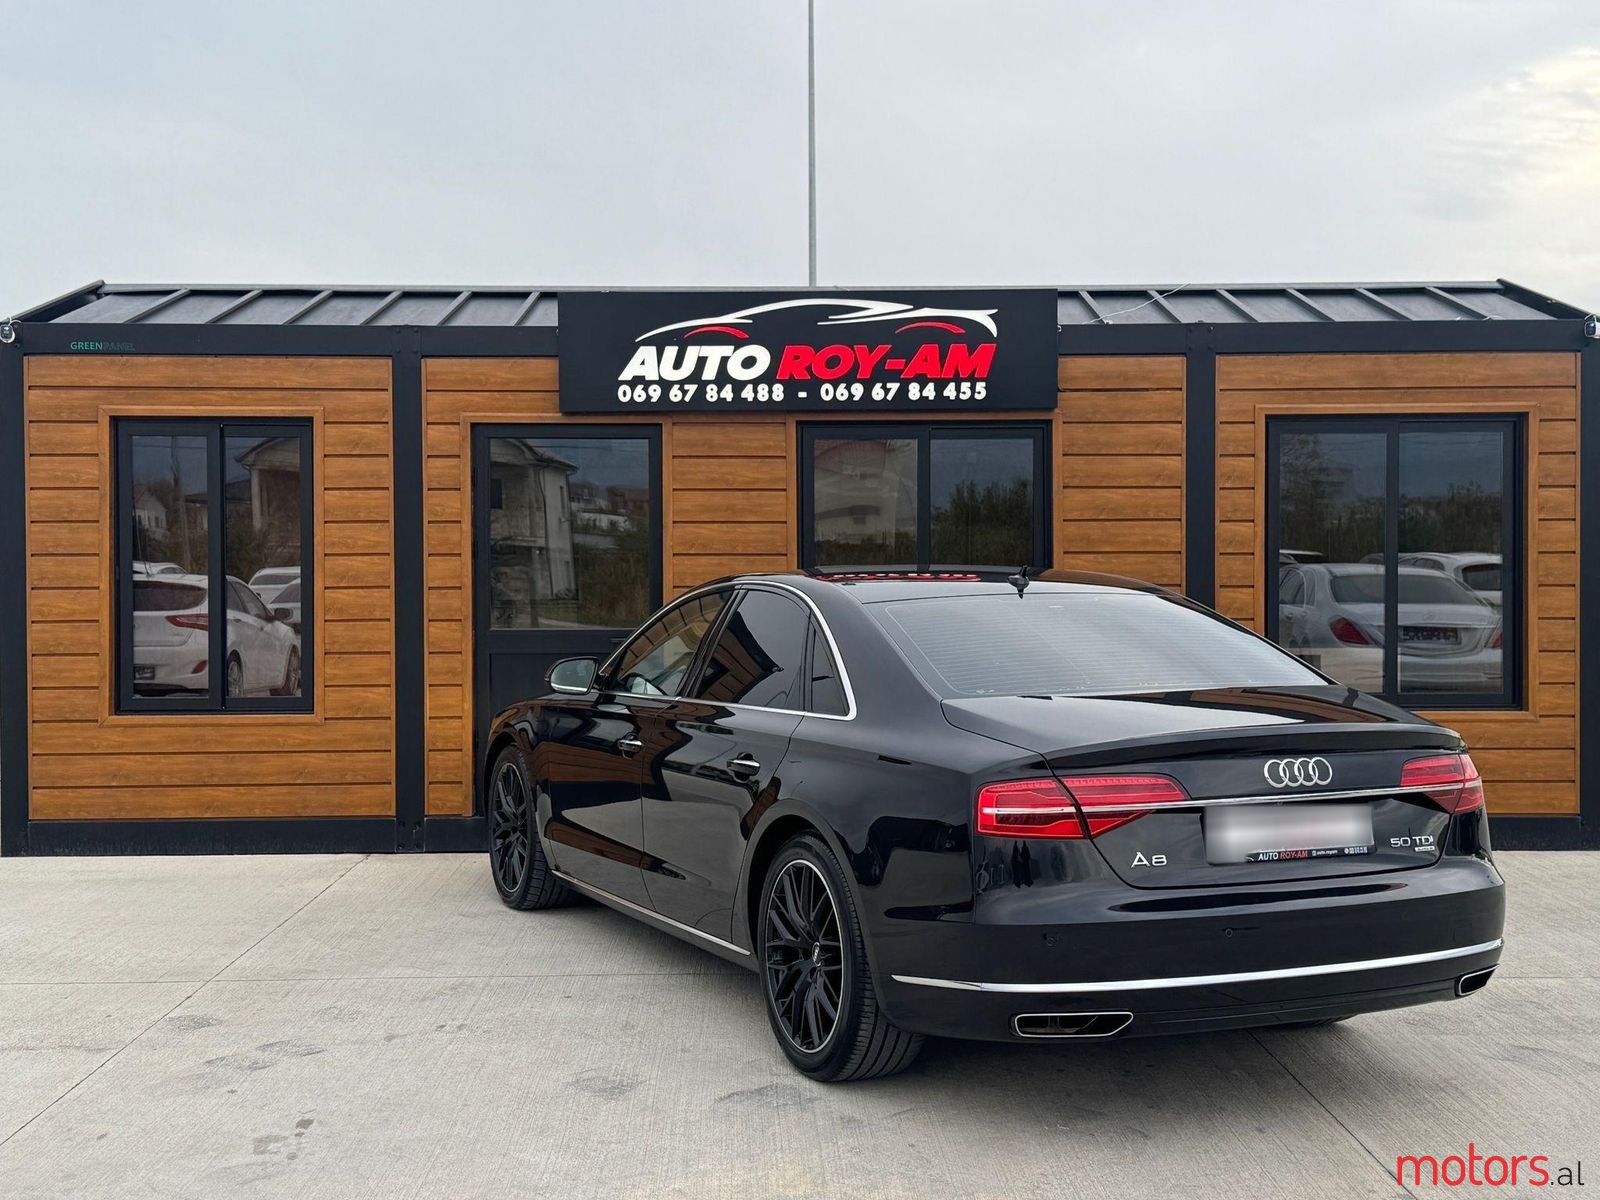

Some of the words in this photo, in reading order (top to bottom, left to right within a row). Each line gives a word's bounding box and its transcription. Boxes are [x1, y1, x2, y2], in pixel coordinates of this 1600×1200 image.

[617, 344, 772, 382] AUTO
[776, 343, 997, 380] ROY-AM
[617, 384, 662, 403] 069
[669, 384, 698, 402] 67
[705, 384, 734, 402] 84
[740, 383, 785, 402] 488
[820, 382, 864, 401] 069
[871, 382, 901, 401] 67
[908, 382, 936, 401] 84
[943, 381, 987, 400] 455
[1390, 837, 1411, 848] 50
[1130, 851, 1167, 868] A8
[1258, 852, 1279, 861] AUTO
[1280, 849, 1308, 859] ROY-AM
